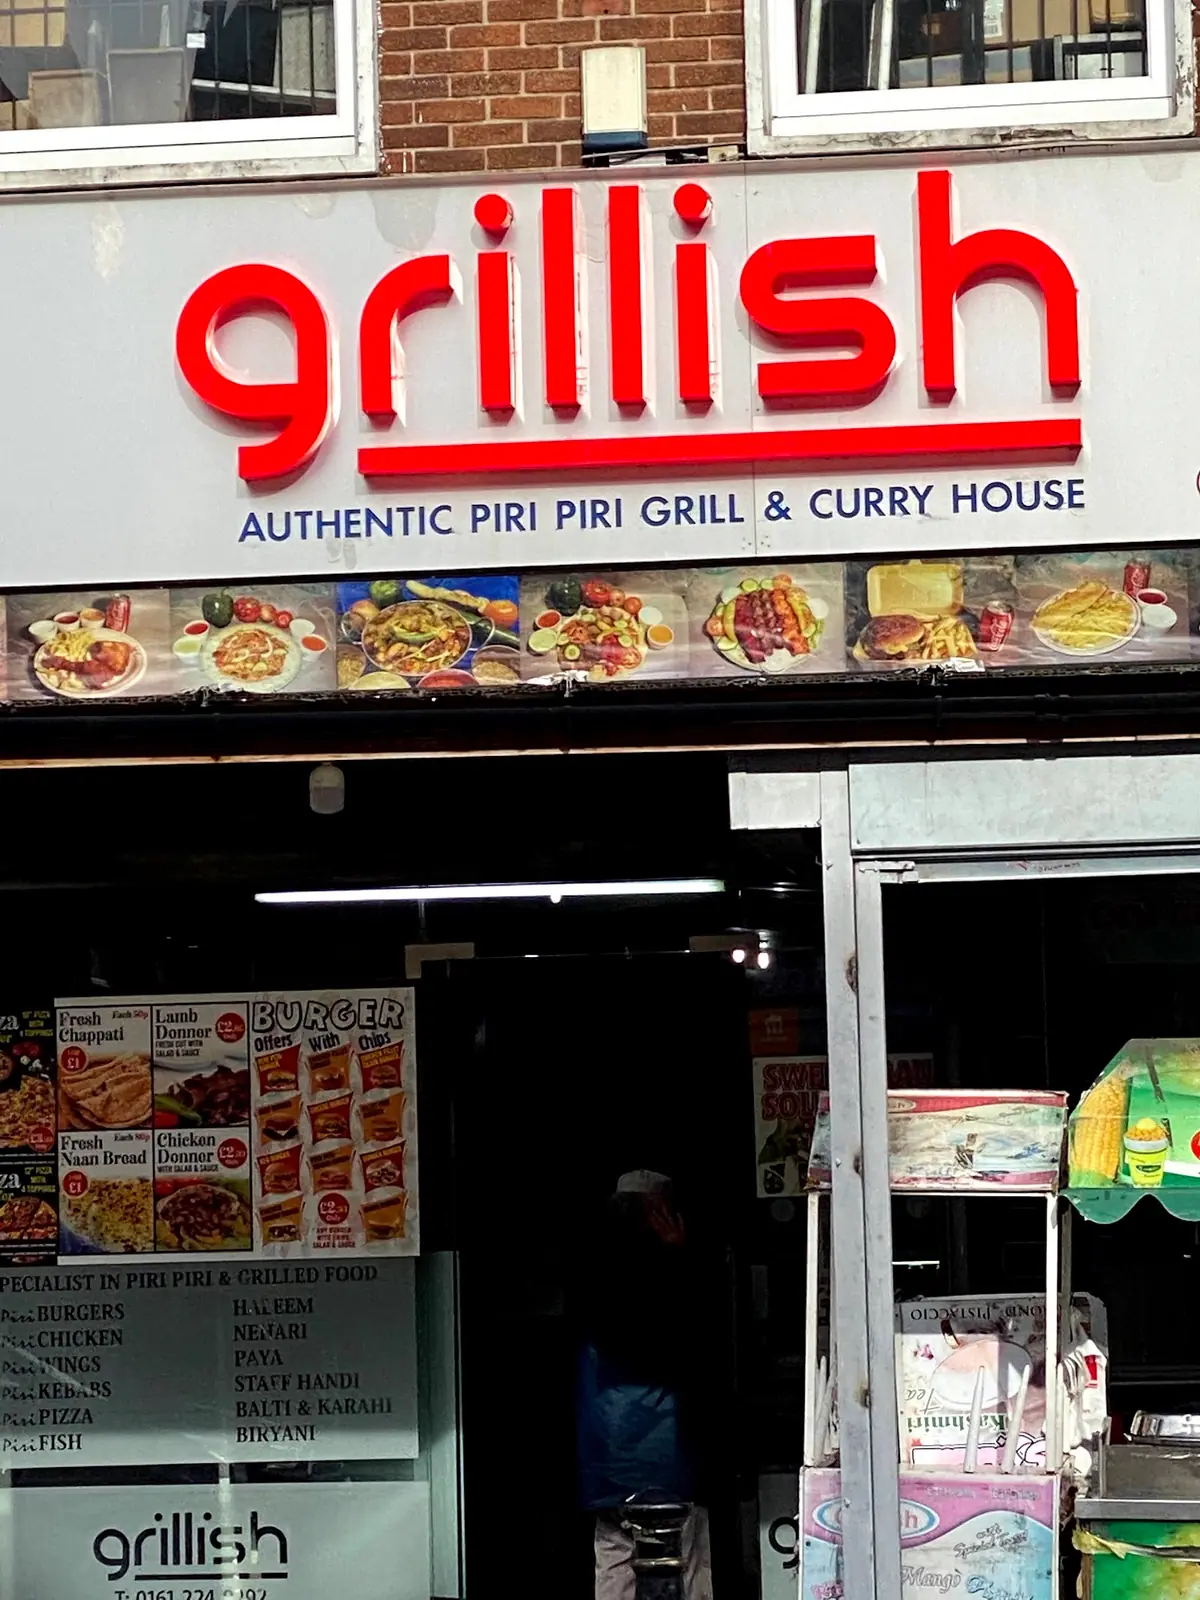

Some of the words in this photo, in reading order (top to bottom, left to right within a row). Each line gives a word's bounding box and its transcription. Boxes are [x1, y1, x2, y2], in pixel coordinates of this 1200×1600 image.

[176, 168, 1082, 480] grillish
[238, 504, 453, 543] AUTHENTIC
[470, 501, 537, 534] PIRI
[555, 498, 623, 531] PIRI
[640, 493, 745, 527] GRILL
[763, 490, 793, 521] &
[808, 484, 934, 519] CURRY
[951, 478, 1086, 514] HOUSE
[60, 1011, 102, 1026] Fresh
[155, 1008, 198, 1023] Lamb
[252, 998, 404, 1033] BURGER
[59, 1026, 125, 1046] Chappati
[155, 1025, 213, 1040] Donner
[358, 1032, 392, 1051] Chips
[254, 1033, 293, 1053] Offers
[308, 1032, 341, 1053] With
[67, 1057, 80, 1069] £1
[60, 1135, 103, 1150] Fresh
[156, 1132, 216, 1148] Chicken
[60, 1152, 100, 1167] Naan
[103, 1150, 147, 1166] Bread
[157, 1149, 214, 1164] Donner
[69, 1182, 82, 1194] £1
[0, 1274, 95, 1293] PECIALIST
[100, 1273, 120, 1290] IN
[126, 1272, 167, 1289] PIRI
[172, 1270, 212, 1288] PIRI
[218, 1270, 231, 1286] &
[237, 1266, 320, 1285] GRILLED
[324, 1265, 378, 1283] FOOD
[37, 1303, 125, 1323] BURGERS
[910, 1306, 992, 1322] PISTACCIO
[37, 1328, 124, 1348] CHICKEN
[234, 1349, 284, 1367] PAYA
[296, 1372, 360, 1391] HANDI
[236, 1399, 292, 1418] BALTI
[297, 1400, 311, 1417] &
[317, 1397, 392, 1416] KARAHI
[38, 1408, 94, 1426] PIZZA
[38, 1433, 83, 1451] FISH
[236, 1425, 316, 1443] BIRYANI
[93, 1511, 288, 1581] grillish
